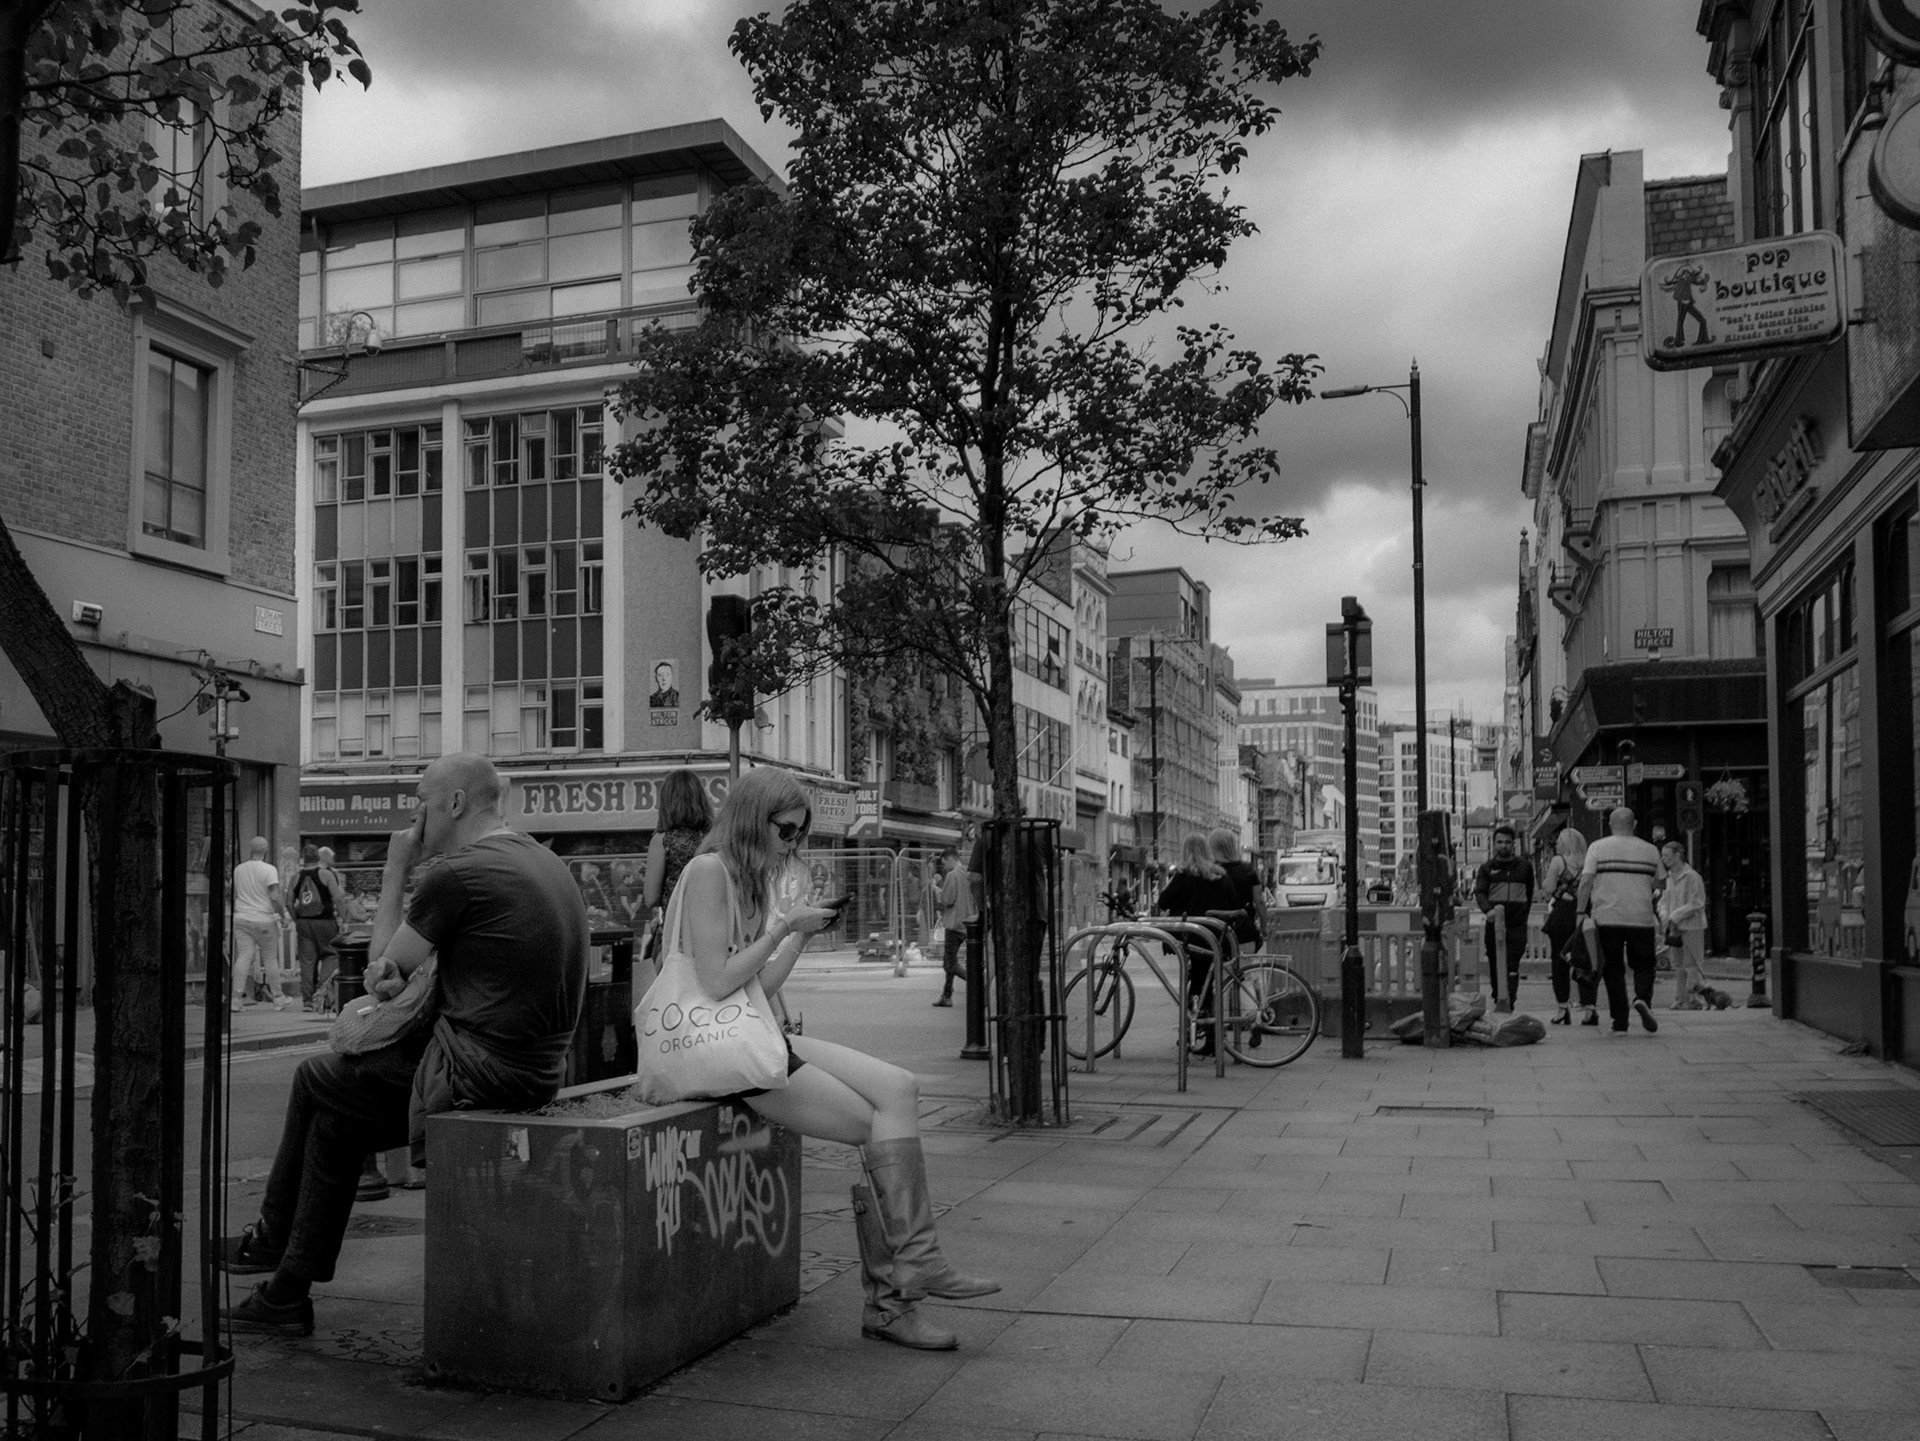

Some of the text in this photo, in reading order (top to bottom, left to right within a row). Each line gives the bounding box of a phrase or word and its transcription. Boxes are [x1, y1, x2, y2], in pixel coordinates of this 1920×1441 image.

[1745, 248, 1790, 273] pop
[1714, 270, 1826, 300] boutique
[1636, 637, 1671, 647] STREET
[1637, 628, 1670, 638] HILTON
[299, 793, 420, 813] Hilton Aqua Em
[522, 781, 626, 815] FRESH
[818, 796, 848, 807] FRESH
[819, 806, 846, 816] BITES
[660, 1026, 738, 1053] ORGANIC
